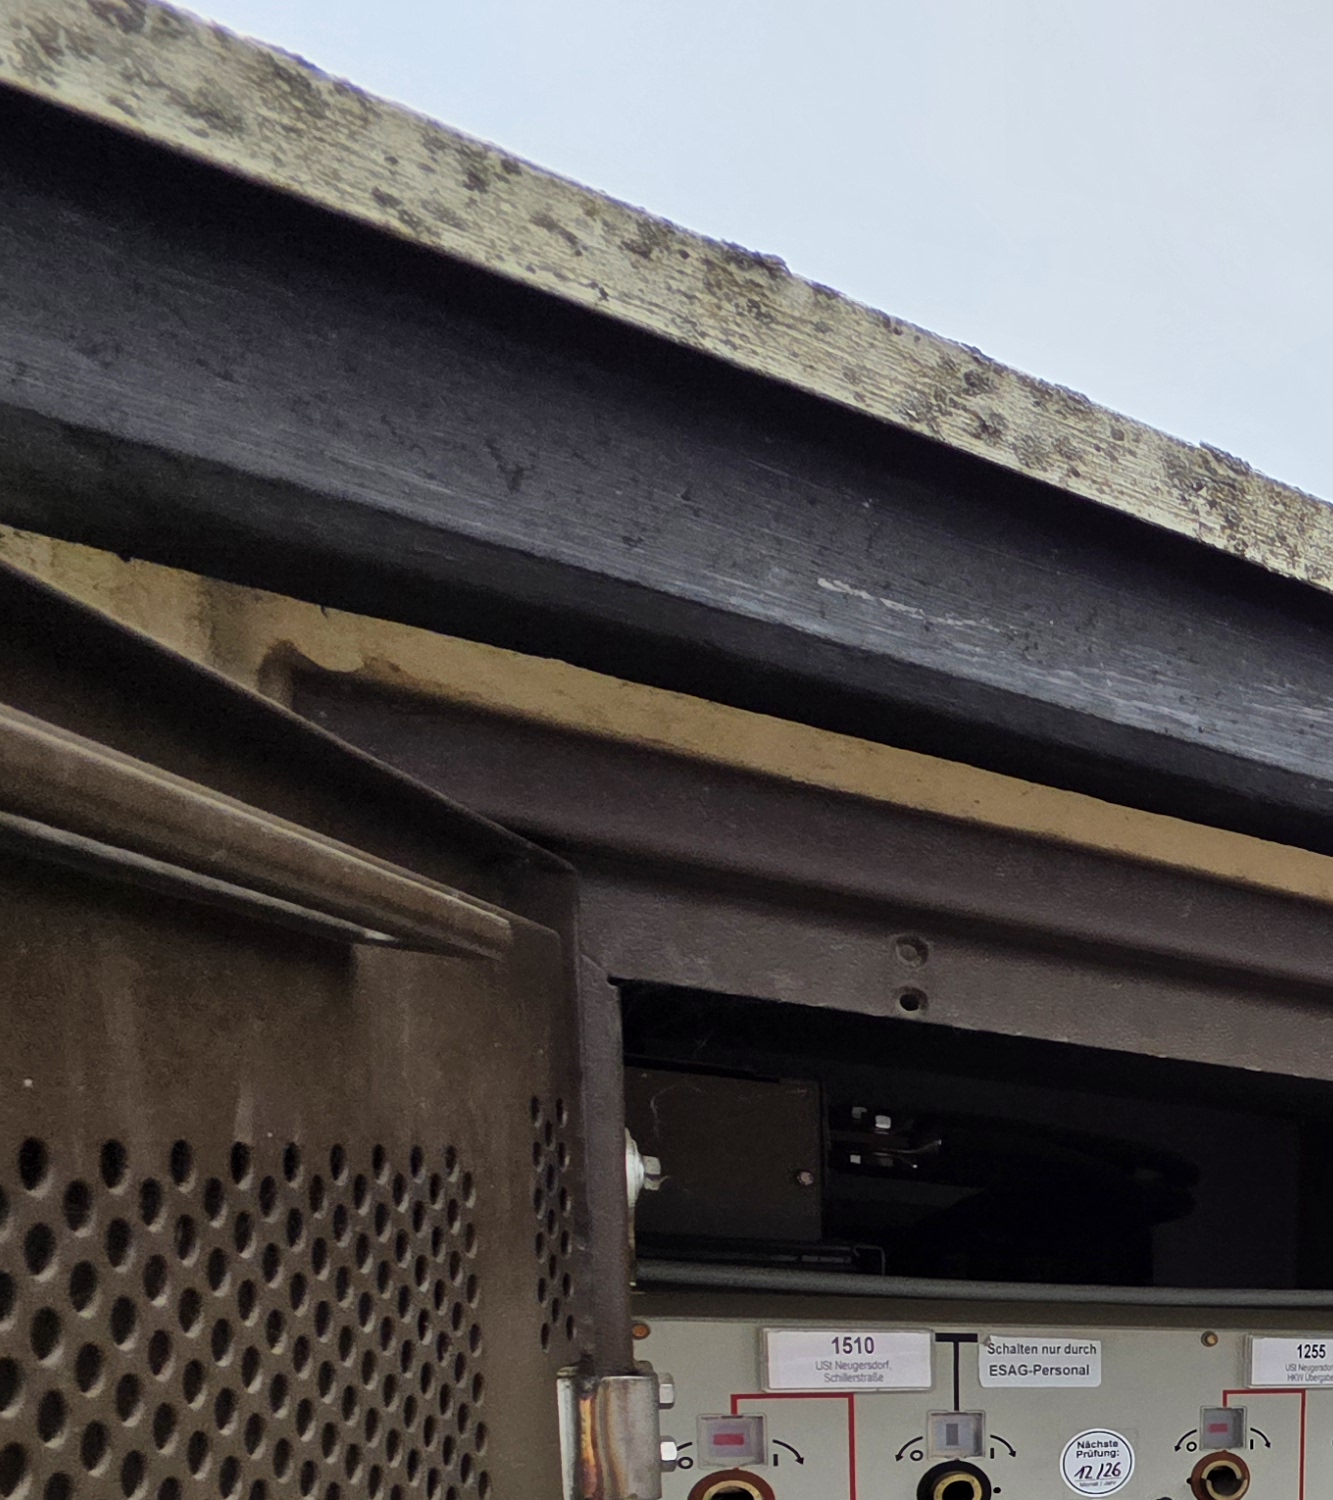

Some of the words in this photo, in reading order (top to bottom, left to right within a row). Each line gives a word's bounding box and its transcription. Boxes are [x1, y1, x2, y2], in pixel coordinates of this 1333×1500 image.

[831, 1336, 875, 1355] 1510
[987, 1343, 1038, 1355] Schalten
[1041, 1345, 1061, 1355] nur
[1064, 1343, 1097, 1355] durch
[1297, 1344, 1326, 1359] 1255
[815, 1361, 832, 1371] USt
[989, 1364, 1090, 1376] ESAG-Personal
[824, 1373, 884, 1383] Schillerstraße
[1305, 1372, 1333, 1383] Übergabe
[1077, 1440, 1118, 1449] Nächste
[1076, 1449, 1120, 1458] Prüfung:
